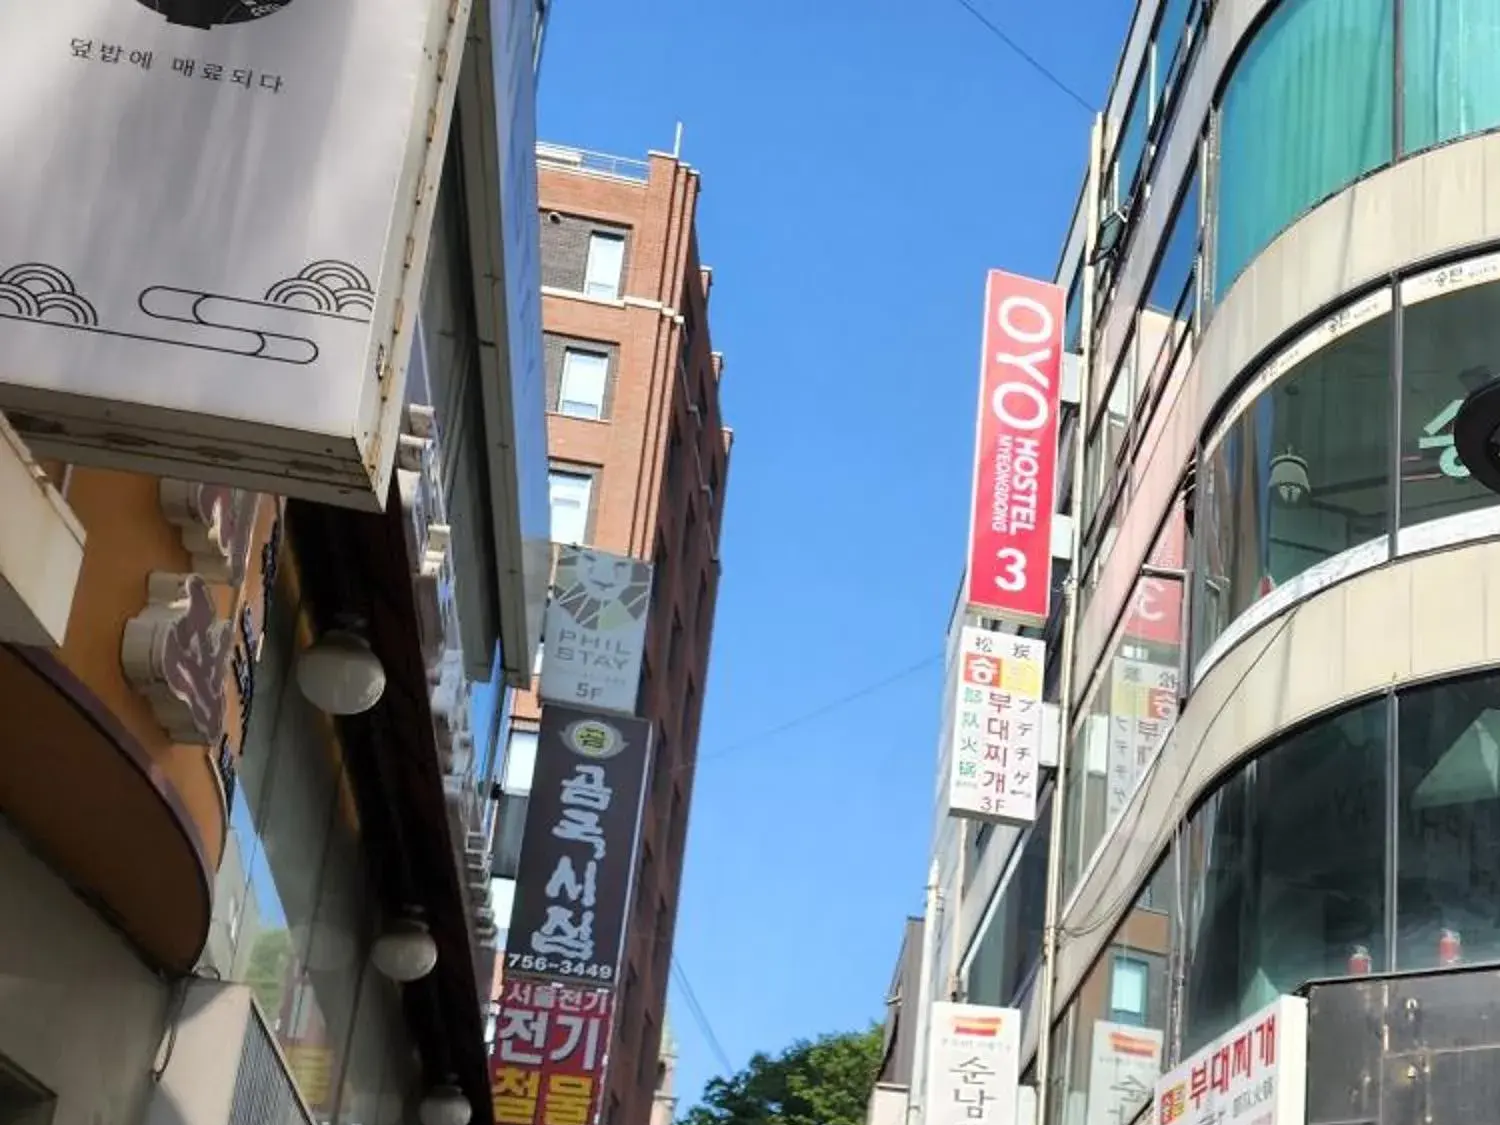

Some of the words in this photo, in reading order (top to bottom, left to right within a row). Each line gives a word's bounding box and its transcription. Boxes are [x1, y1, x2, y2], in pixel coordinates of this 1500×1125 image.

[71, 37, 153, 71] 덮밥에
[172, 58, 283, 94] 매료되다
[992, 296, 1053, 430] OYO
[1010, 437, 1039, 536] HOSTEL
[994, 547, 1027, 592] 3
[554, 645, 630, 671] STAY
[558, 628, 630, 656] PHIL
[575, 682, 603, 700] 5F
[981, 692, 1012, 794] 부대찌개
[980, 798, 1006, 813] 3F
[508, 953, 612, 980] 756-3449
[499, 1008, 599, 1070] 전기
[1190, 1014, 1275, 1109] 부대찌개
